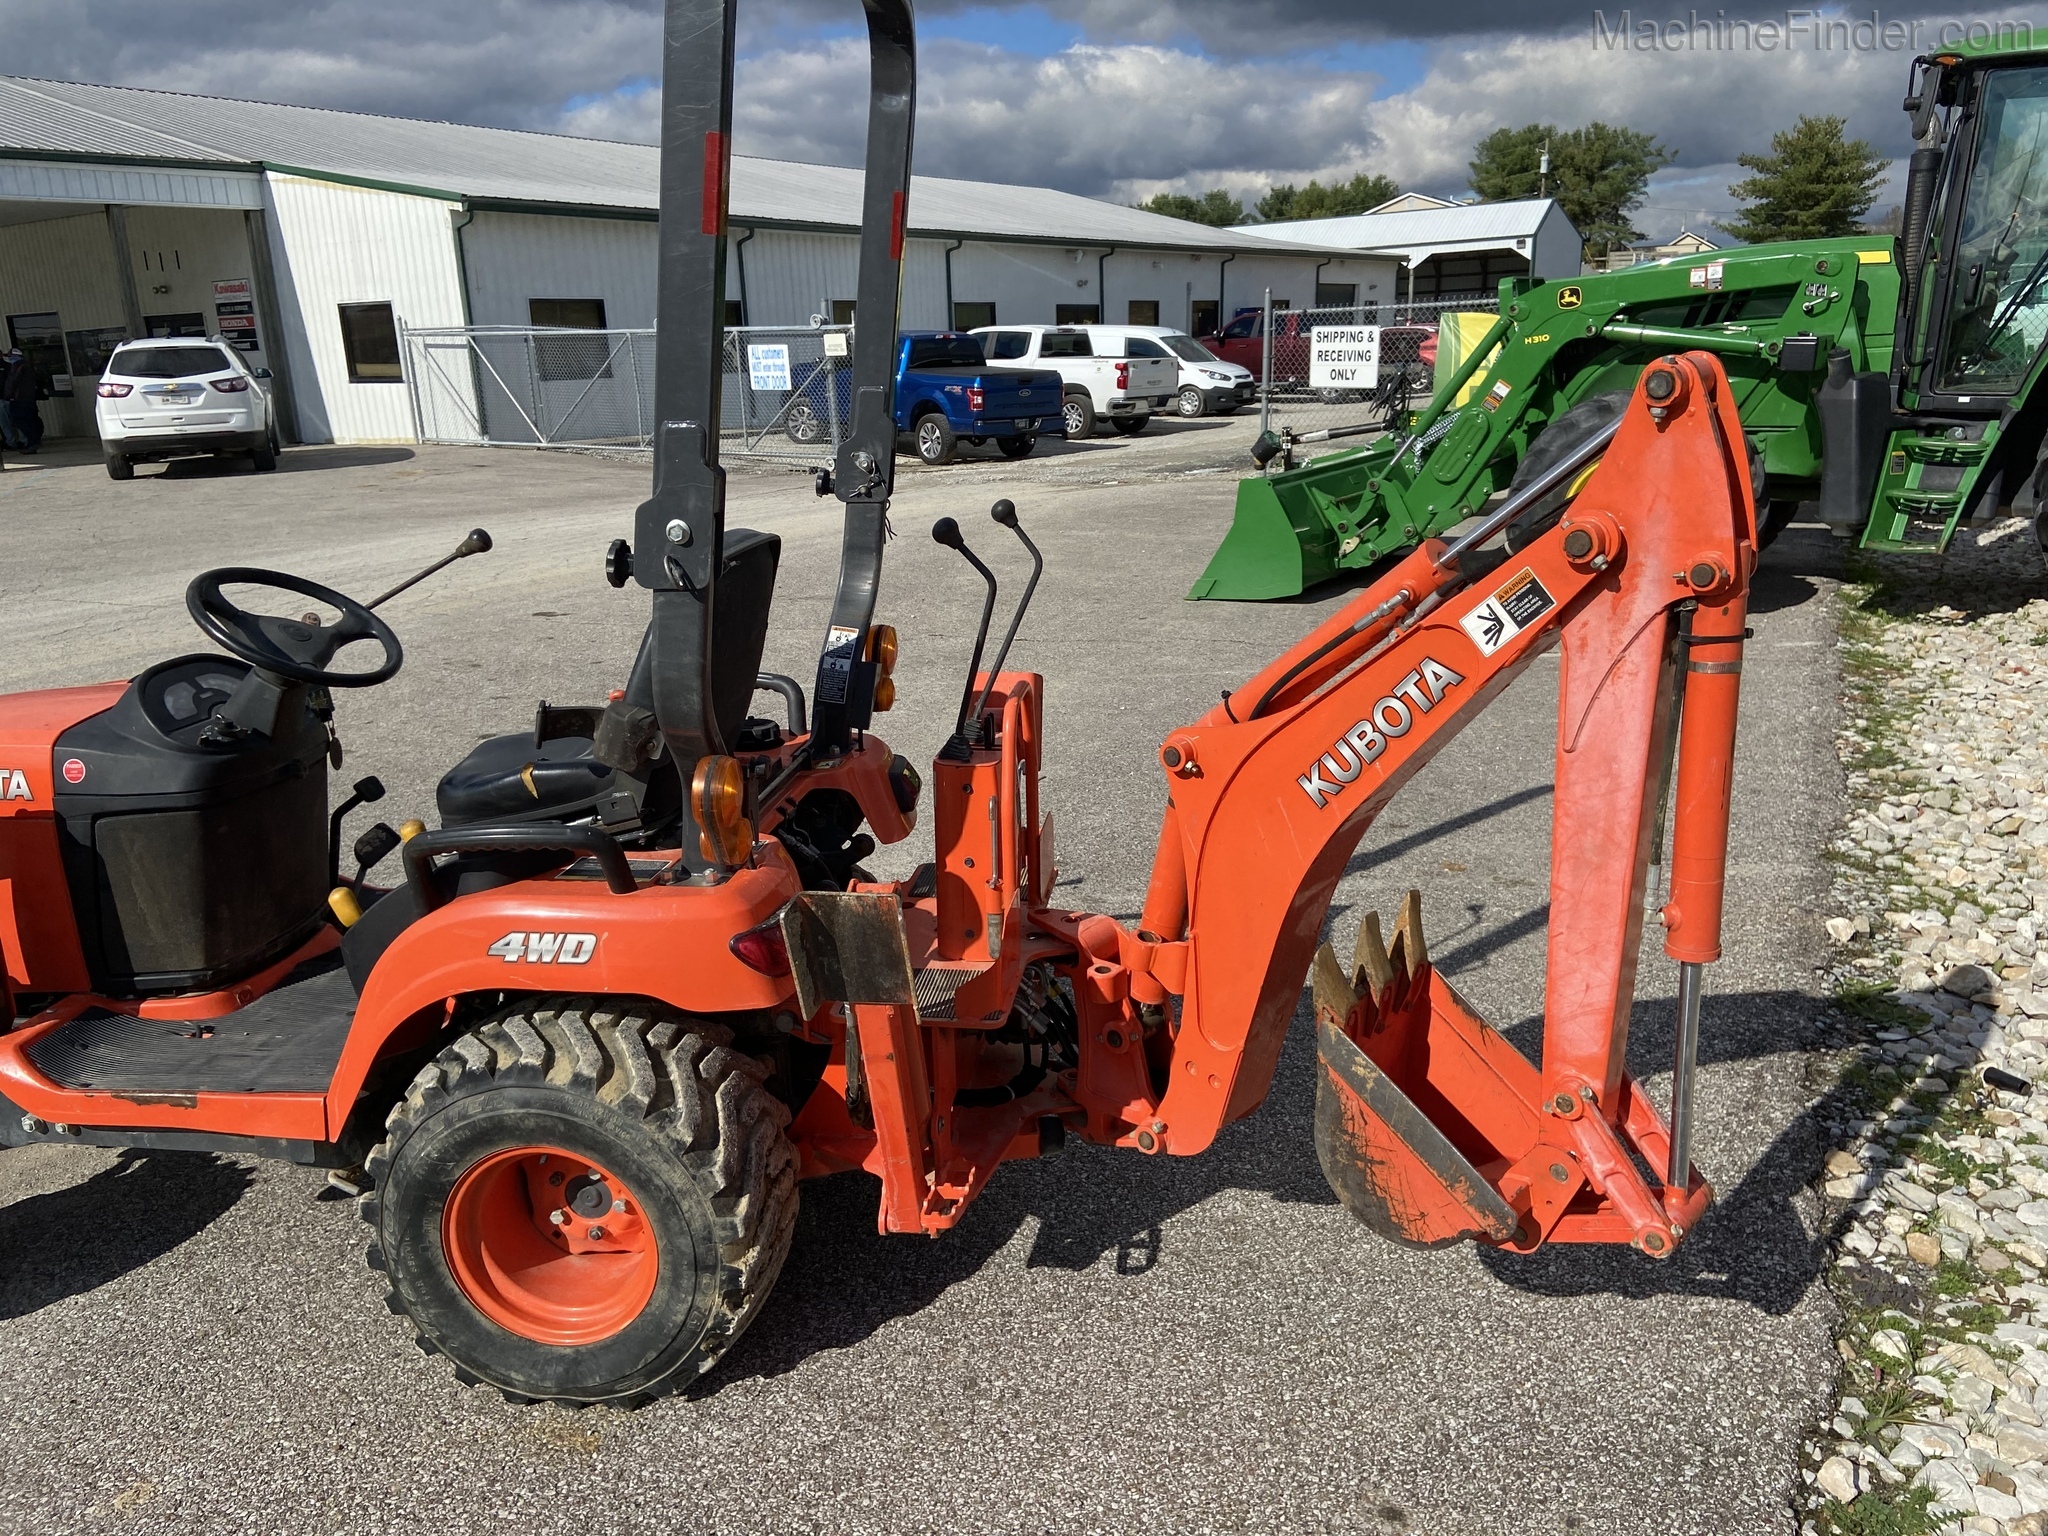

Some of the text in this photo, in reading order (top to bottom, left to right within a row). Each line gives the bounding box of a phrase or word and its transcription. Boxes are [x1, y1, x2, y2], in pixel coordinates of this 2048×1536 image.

[214, 281, 248, 294] Kawasaki
[221, 318, 249, 327] HONDA
[1316, 331, 1374, 342] SHIPPING &
[1524, 334, 1550, 344] H310
[1317, 350, 1372, 362] RECEIVING
[1330, 369, 1356, 380] ONLY
[754, 376, 788, 389] FRONT DOOR
[1502, 572, 1530, 596] WARNING
[1297, 656, 1466, 809] KUBOTA
[487, 931, 597, 964] 4WD
